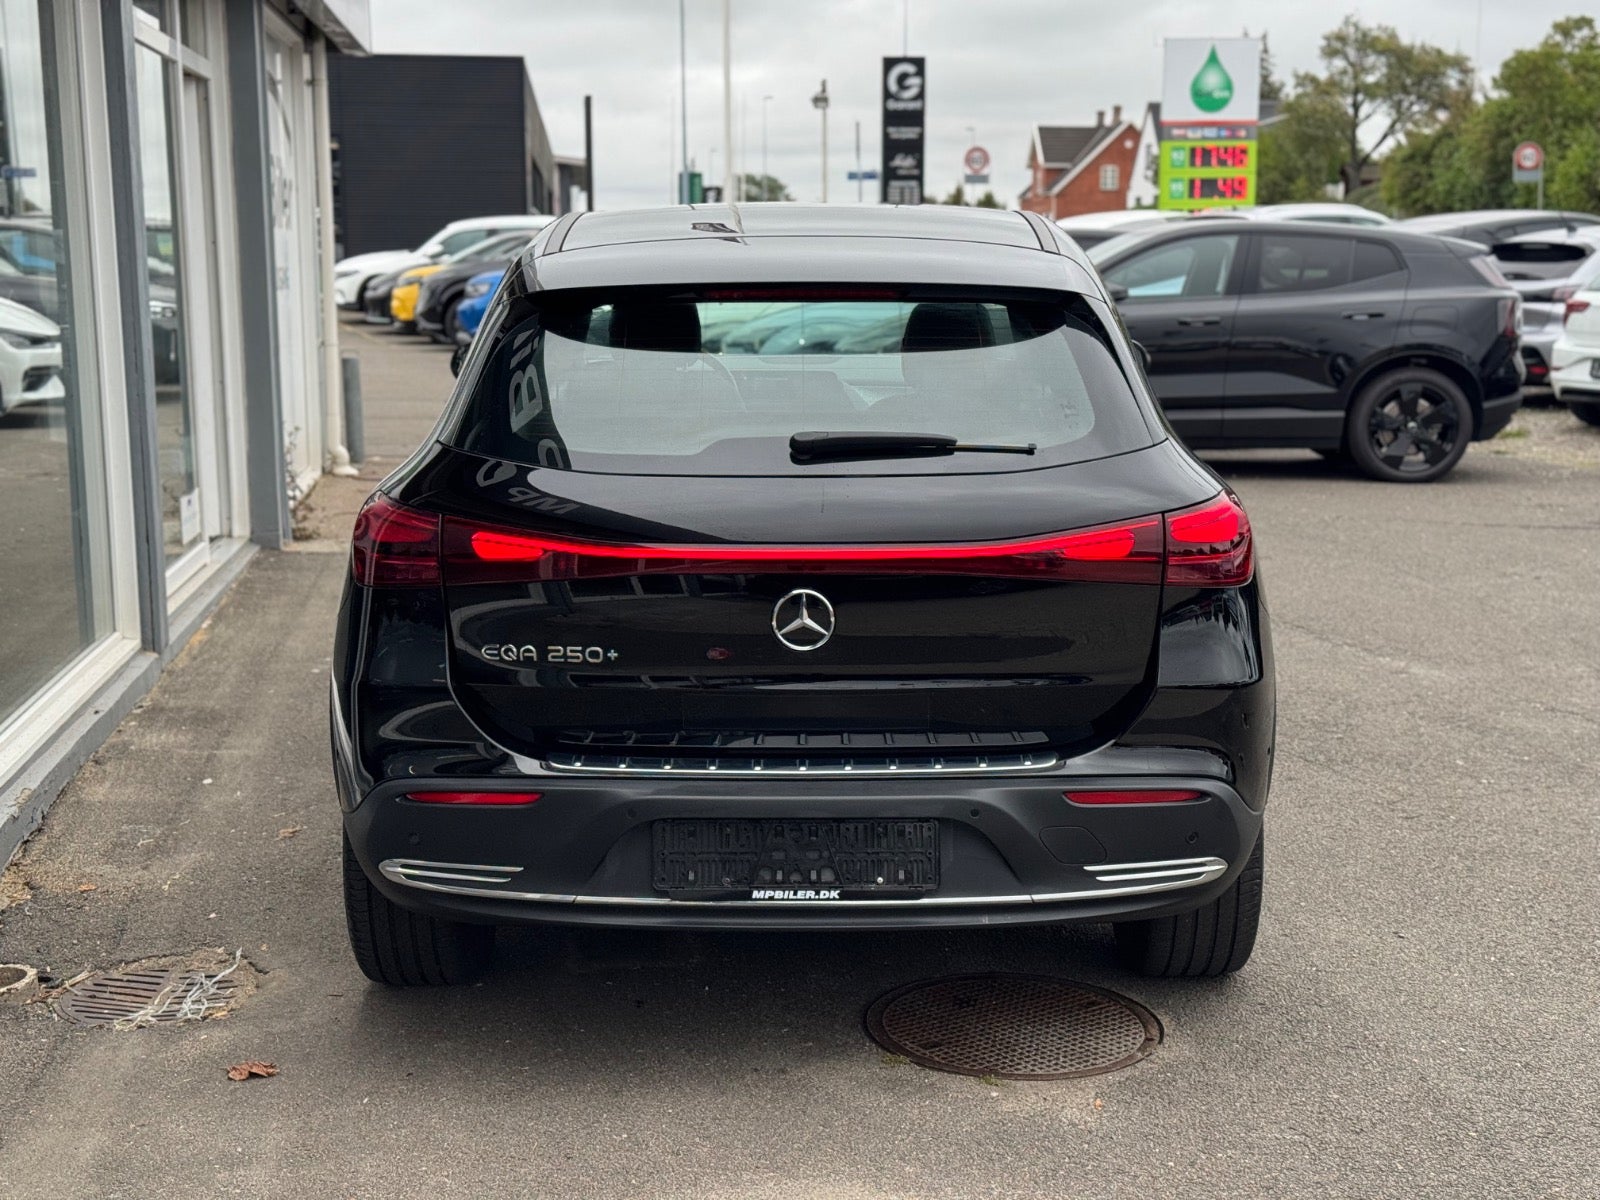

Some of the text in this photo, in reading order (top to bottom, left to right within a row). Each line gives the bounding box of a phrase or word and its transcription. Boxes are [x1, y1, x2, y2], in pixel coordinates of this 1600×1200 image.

[481, 643, 619, 664] EQA 250+
[751, 889, 841, 900] MPBILER.DK
